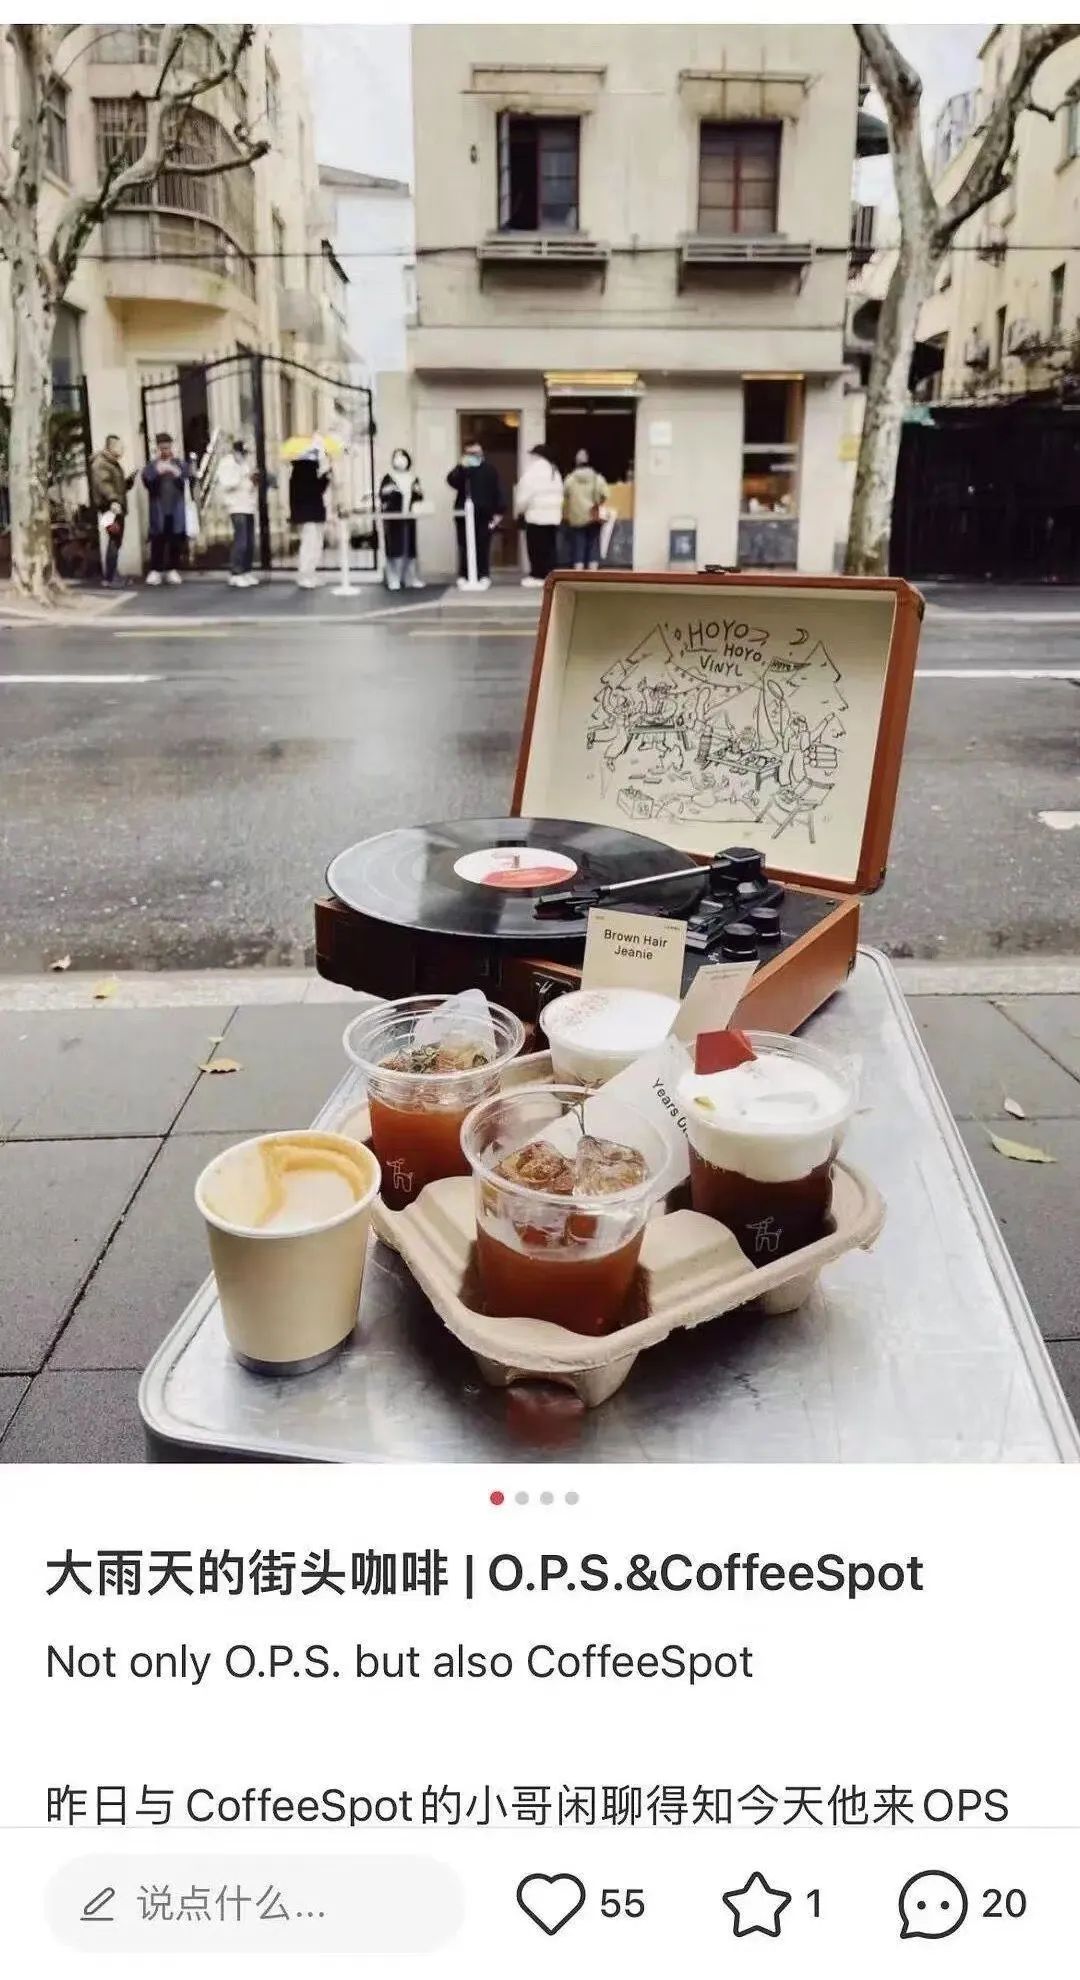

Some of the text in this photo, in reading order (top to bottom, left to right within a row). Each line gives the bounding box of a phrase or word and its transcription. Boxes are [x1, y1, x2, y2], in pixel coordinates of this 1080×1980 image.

[687, 619, 749, 648] HOYO
[723, 643, 762, 661] HOYO
[700, 655, 743, 676] VINYL
[604, 928, 668, 948] Brown Hair
[614, 945, 654, 960] Jeanie
[652, 1077, 680, 1117] Years
